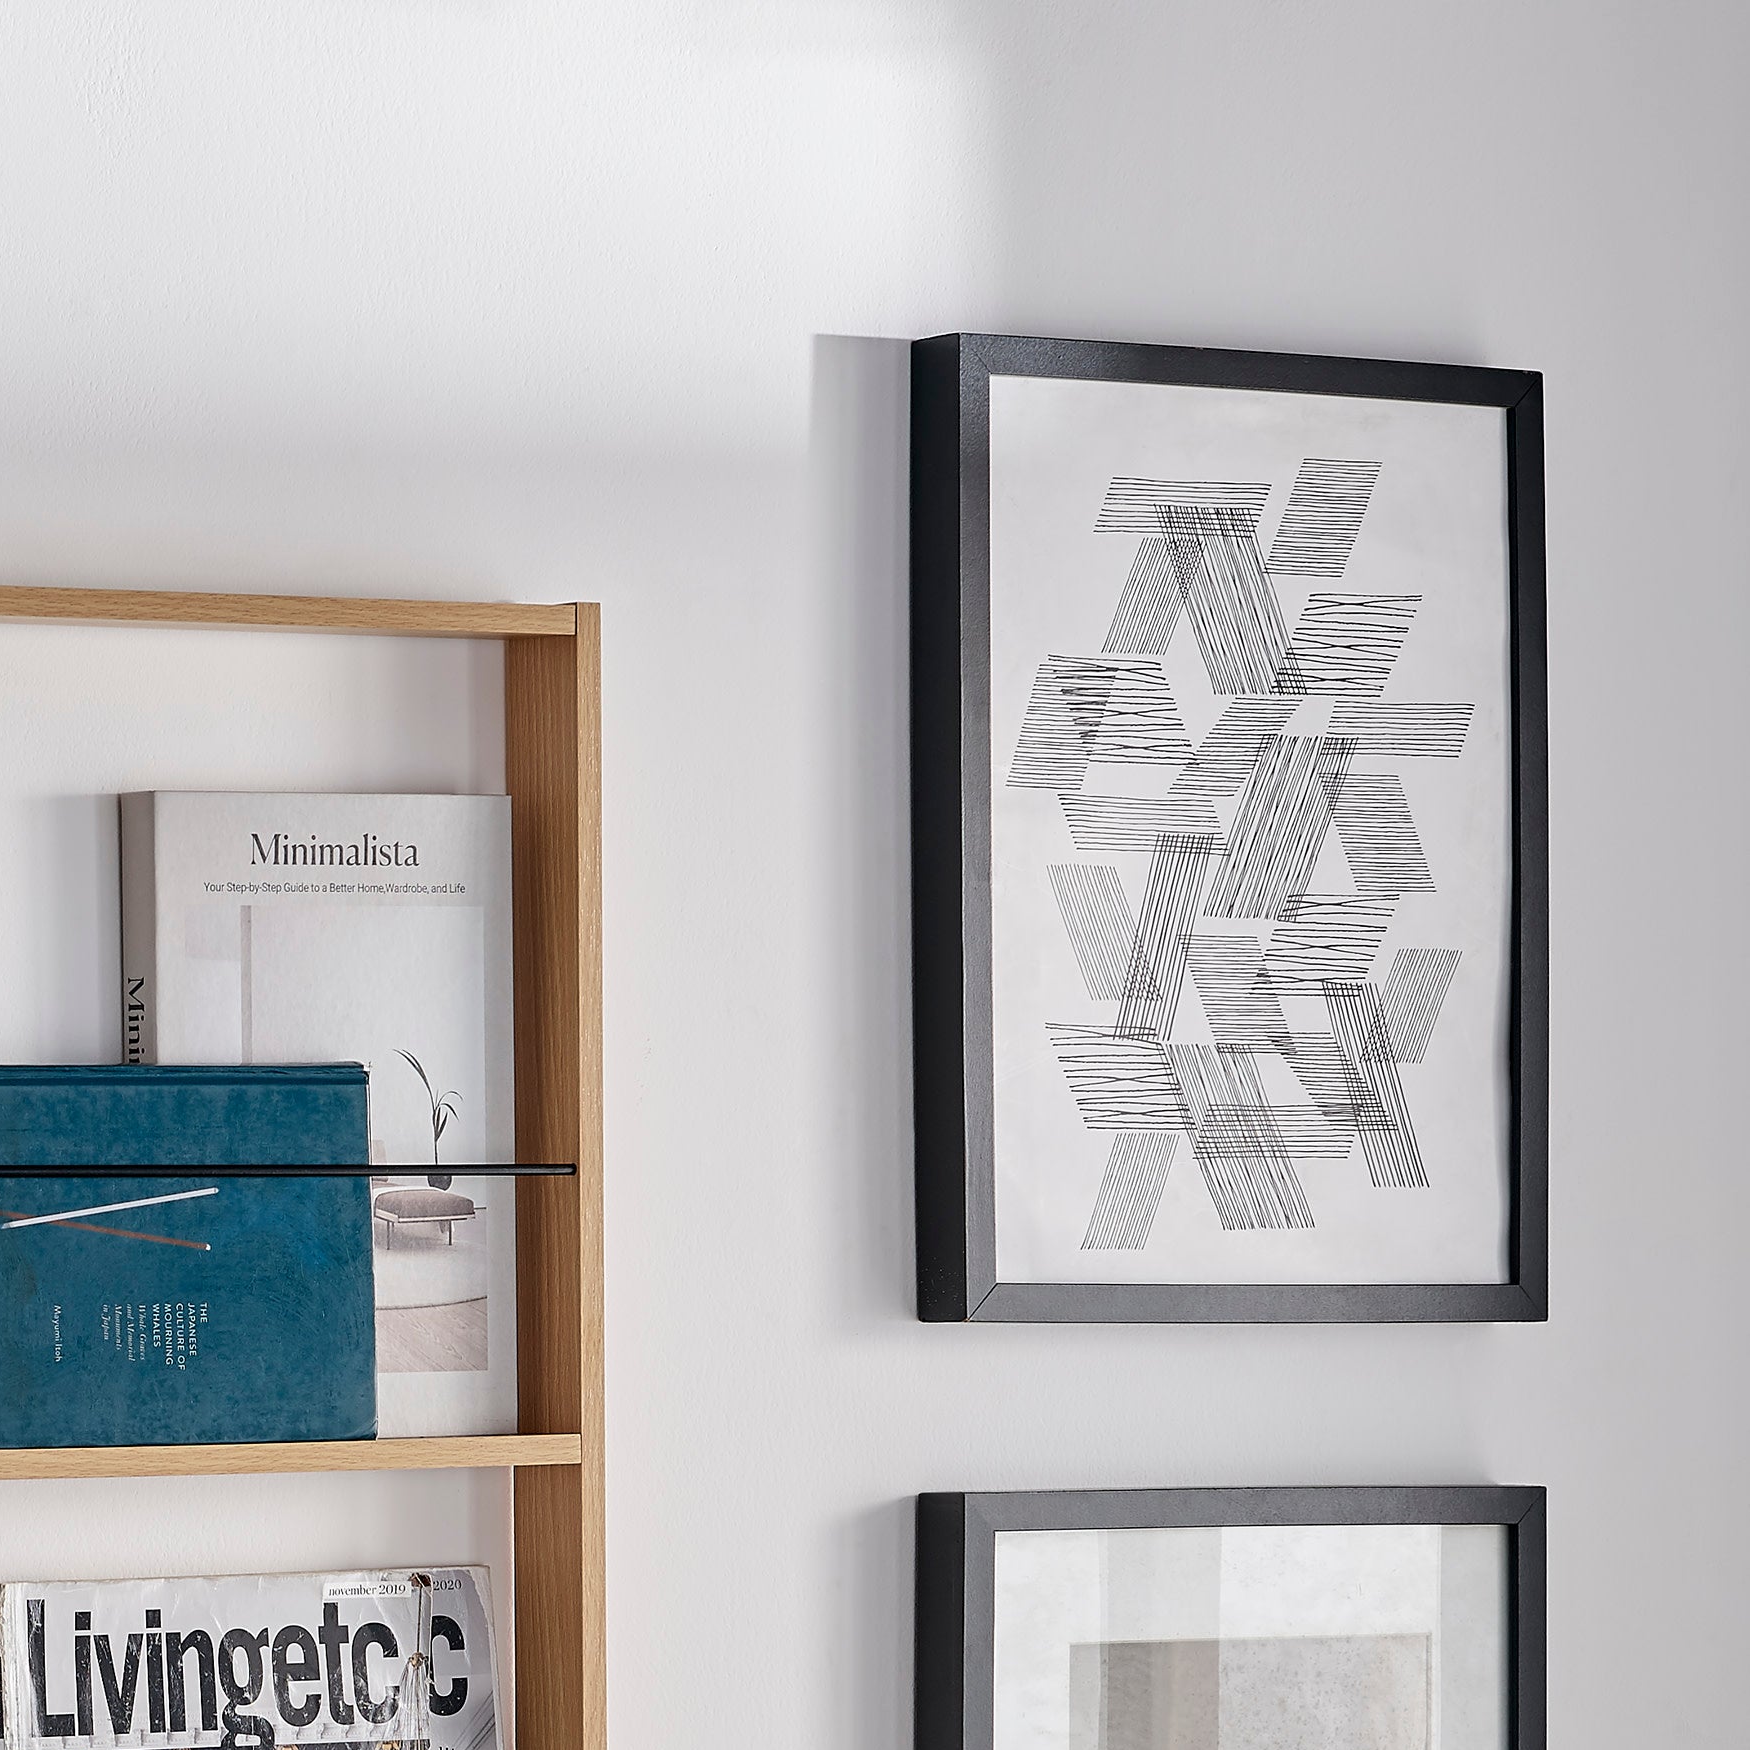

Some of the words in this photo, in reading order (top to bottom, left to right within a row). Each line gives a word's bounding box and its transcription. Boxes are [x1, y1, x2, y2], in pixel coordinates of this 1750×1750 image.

[250, 832, 420, 868] Minimalista
[203, 881, 225, 893] Your
[226, 881, 282, 895] Step-by-Step
[283, 881, 309, 894] Guide
[310, 883, 321, 893] to
[321, 885, 328, 893] a
[329, 882, 356, 894] Better
[431, 883, 448, 894] and
[449, 882, 466, 894] Life
[52, 1304, 62, 1341] Mayumi
[138, 1304, 147, 1331] Whale
[152, 1303, 161, 1348] WHALES
[200, 1302, 208, 1323] THE
[101, 1313, 111, 1340] Japan
[164, 1303, 174, 1366] MOURNING
[175, 1302, 185, 1351] CULTURE
[187, 1302, 197, 1356] JAPANESE
[54, 1344, 63, 1362] Itoh
[177, 1355, 186, 1371] OF
[328, 1584, 377, 1597] november
[378, 1583, 407, 1596] 2019
[433, 1579, 462, 1591] 2020
[26, 1598, 400, 1747] Livingetc
